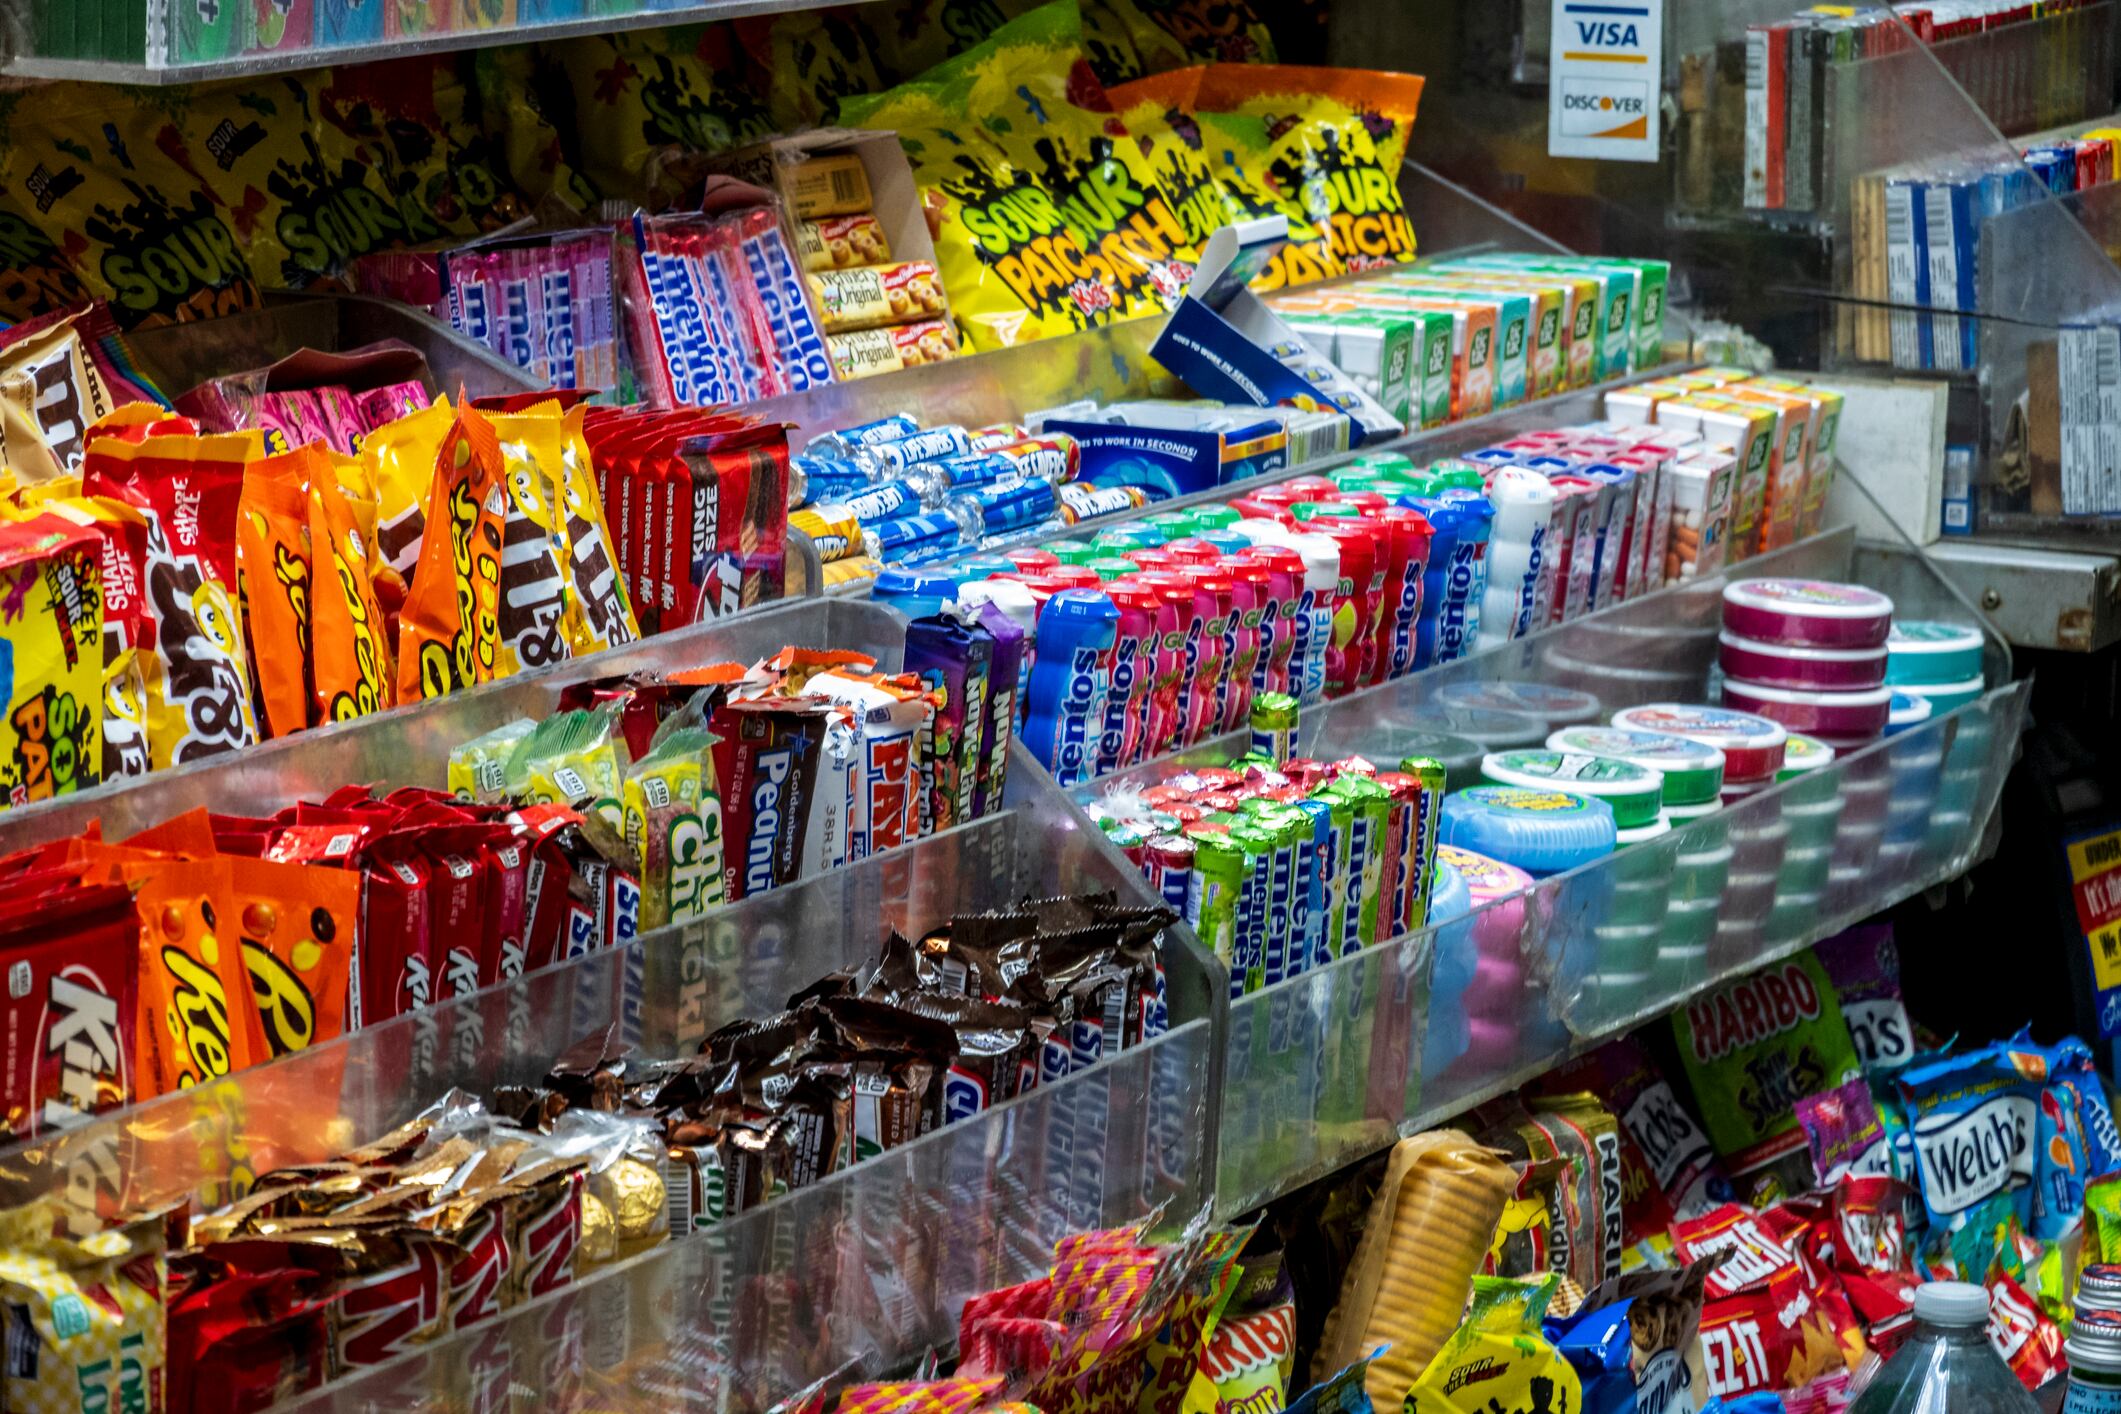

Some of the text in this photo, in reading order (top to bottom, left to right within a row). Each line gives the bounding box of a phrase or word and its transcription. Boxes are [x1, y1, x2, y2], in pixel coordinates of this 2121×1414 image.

[1575, 21, 1639, 47] VISA
[1564, 93, 1643, 115] DISCOVER
[277, 184, 404, 272] SOUR
[962, 187, 1062, 254] SOUR
[103, 216, 245, 311] SOUR
[837, 281, 884, 308] Original
[642, 251, 692, 404] mentos
[848, 338, 896, 366] Original
[1093, 436, 1198, 458] TO WORK IN SECONDS!
[173, 476, 190, 537] SHARE
[692, 488, 706, 563] KING
[705, 484, 718, 552] SIZE
[57, 564, 82, 625] SOUR
[103, 537, 129, 611] SHARE
[117, 549, 137, 596] SIZE
[1307, 607, 1333, 693] WHITE
[565, 770, 584, 793] 190
[655, 780, 668, 805] 190
[871, 738, 911, 851] PAY
[783, 768, 801, 874] Goldenberg's
[1249, 854, 1270, 968] mentos
[1687, 963, 1820, 1064] HARIBO
[1926, 1107, 2027, 1197] Welch's
[1450, 1356, 1494, 1382] SOUR
